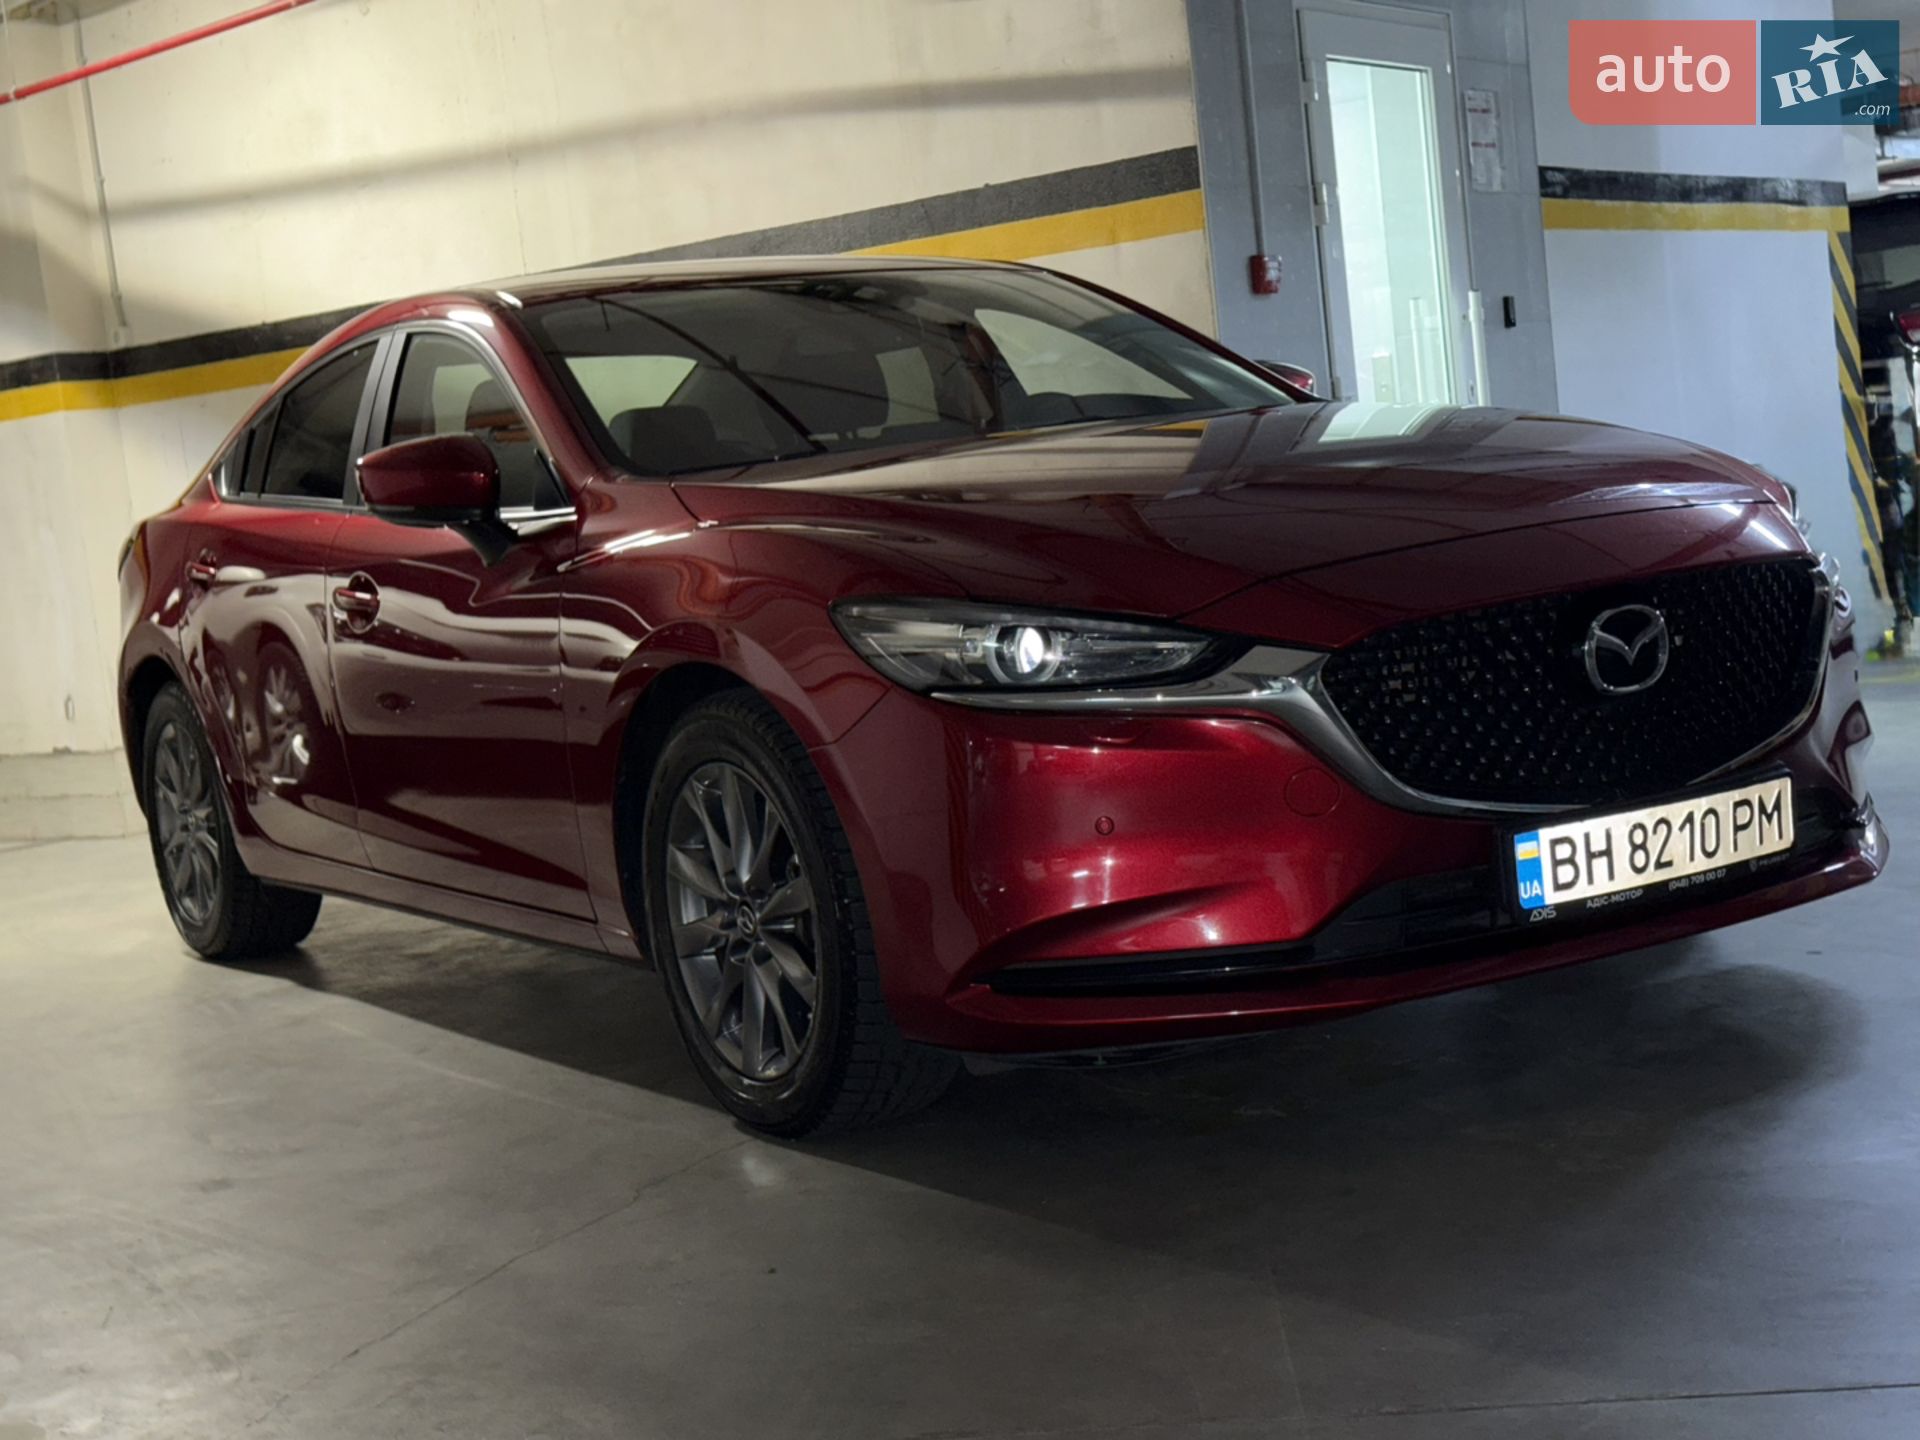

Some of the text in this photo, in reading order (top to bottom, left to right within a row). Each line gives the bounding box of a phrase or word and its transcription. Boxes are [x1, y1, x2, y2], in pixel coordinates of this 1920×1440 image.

[1549, 789, 1784, 893] BH 8210 PM
[1520, 880, 1543, 899] UA
[1529, 906, 1557, 922] ADIS
